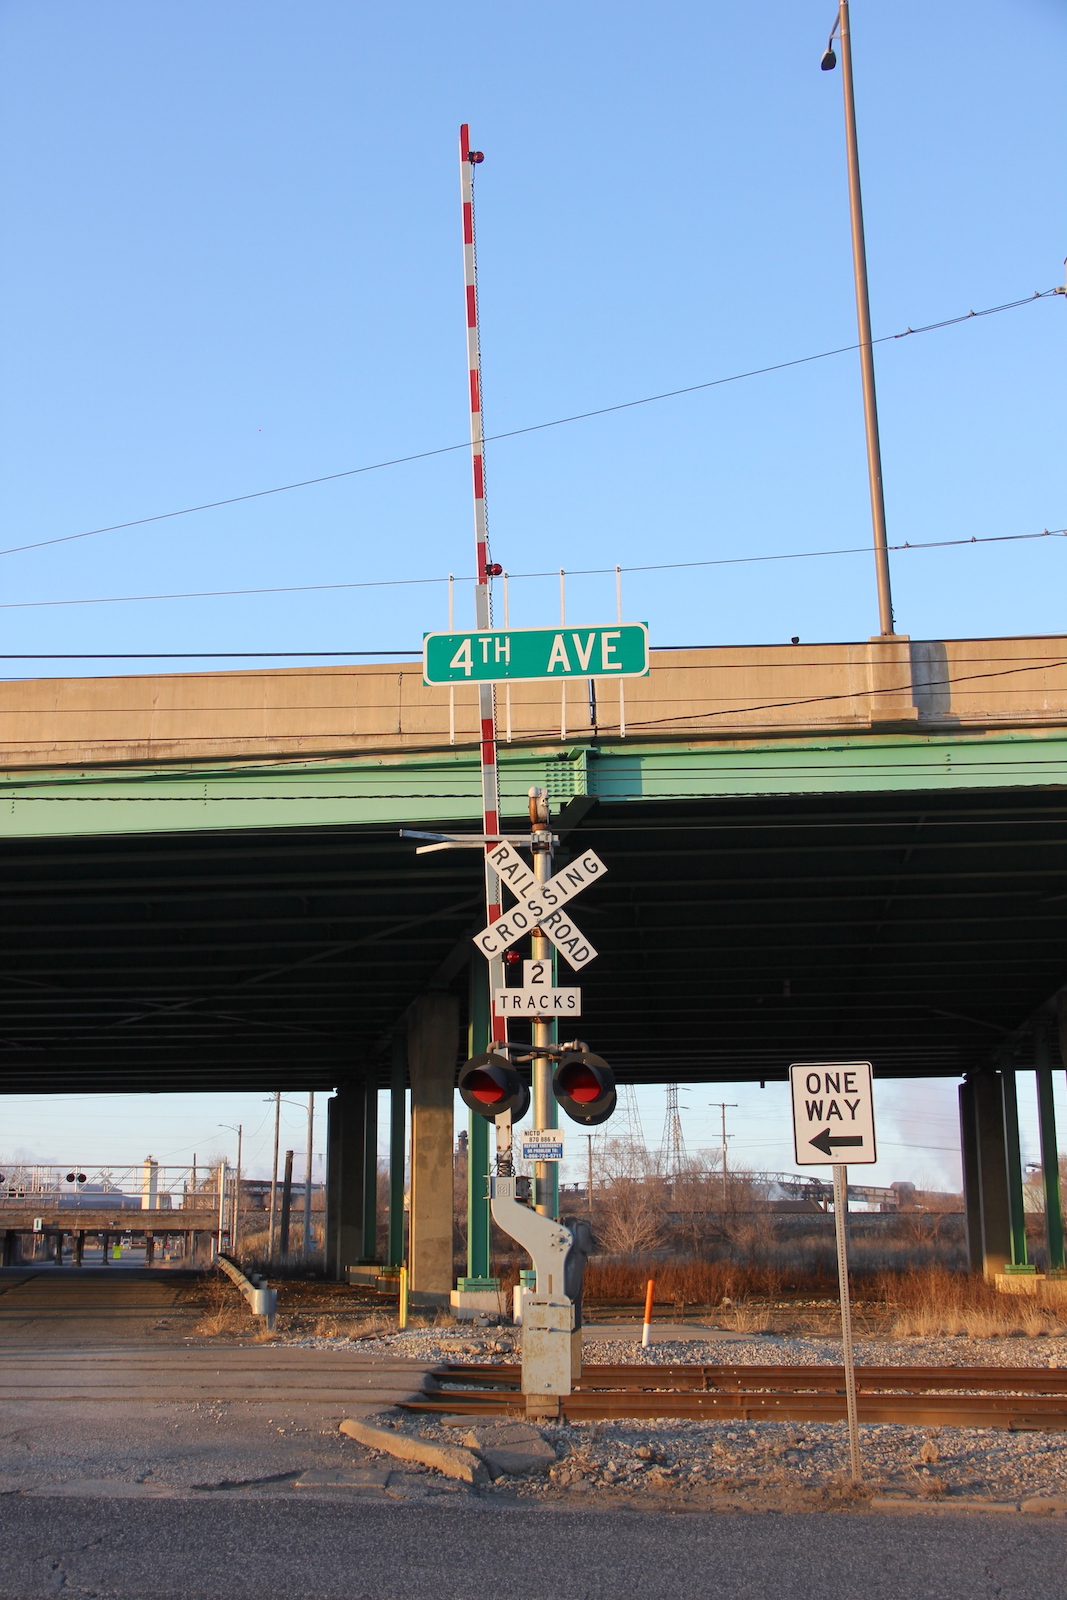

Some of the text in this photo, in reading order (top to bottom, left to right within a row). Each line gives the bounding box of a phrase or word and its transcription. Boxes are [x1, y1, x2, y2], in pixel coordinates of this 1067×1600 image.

[449, 631, 622, 676] 4TH AVE
[481, 857, 599, 953] CROSSING
[491, 846, 590, 963] RAIL ROAD
[531, 965, 544, 984] 2
[500, 995, 576, 1009] TRACKS
[805, 1072, 858, 1094] ONE
[805, 1099, 861, 1121] WAY
